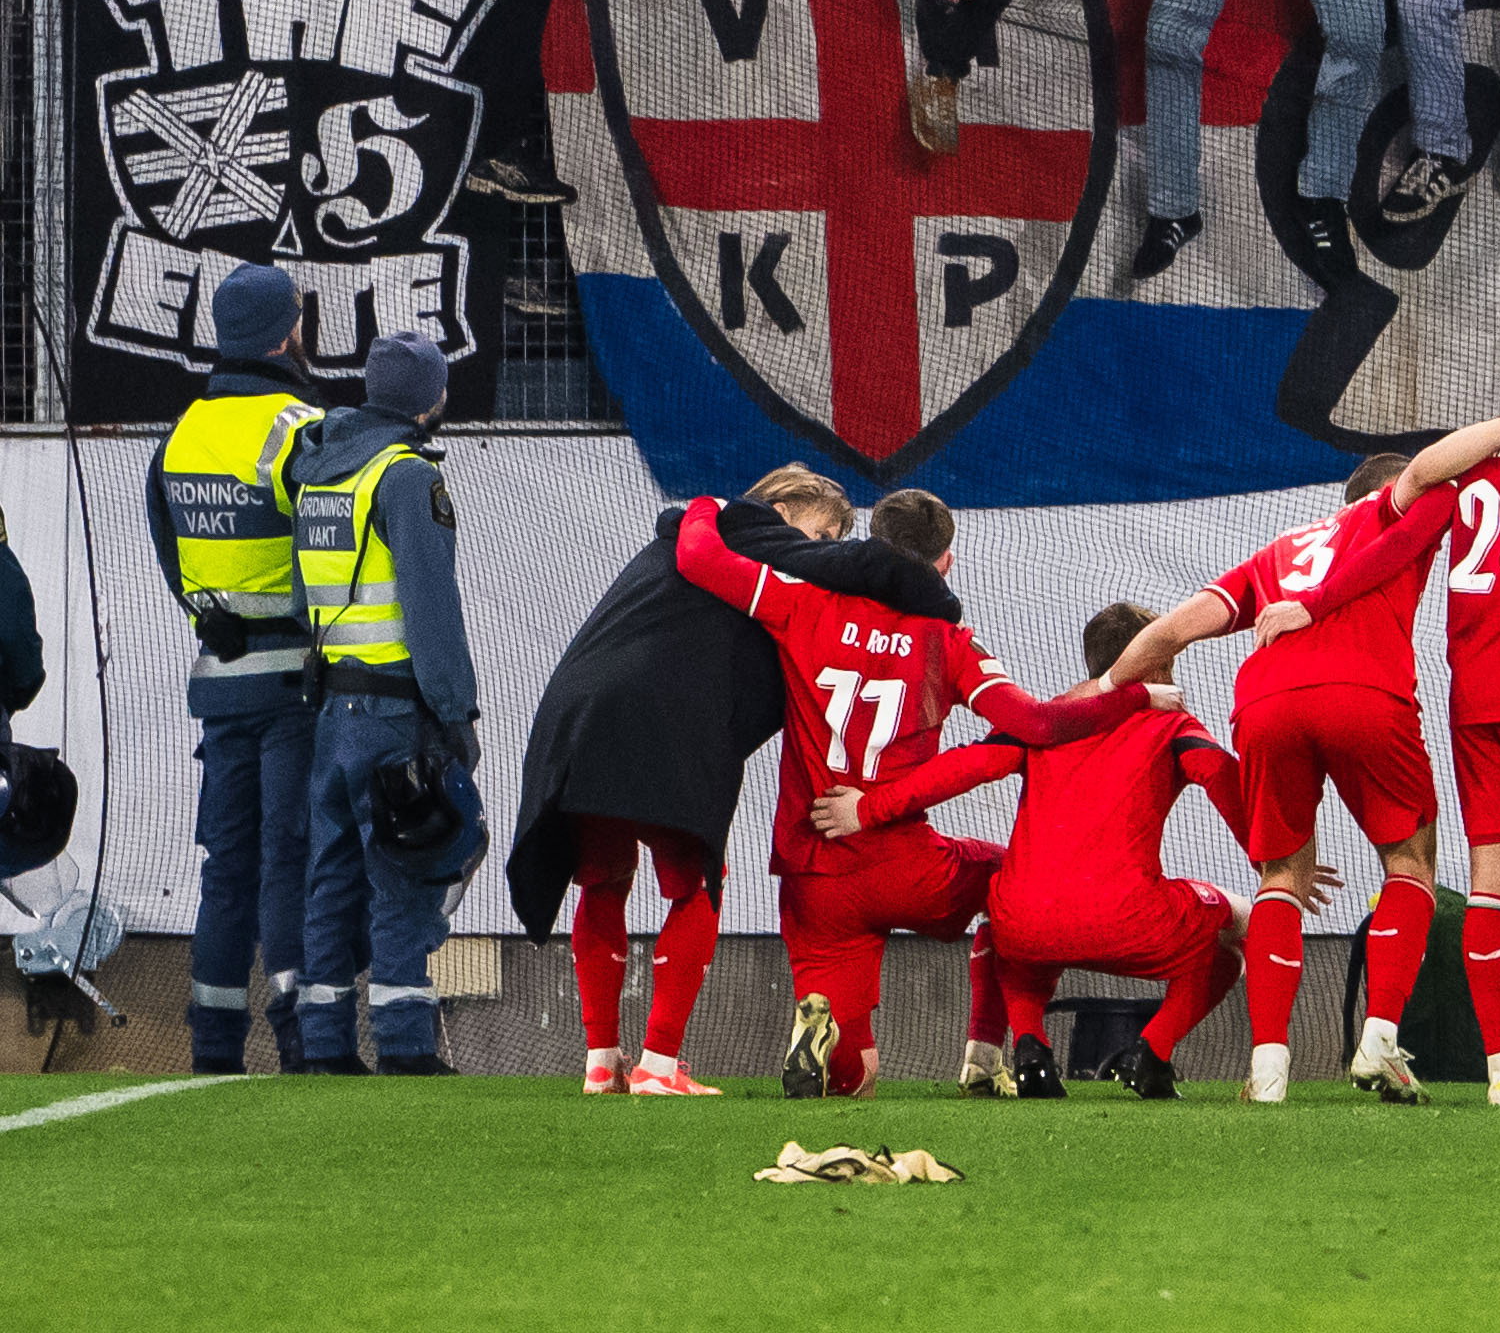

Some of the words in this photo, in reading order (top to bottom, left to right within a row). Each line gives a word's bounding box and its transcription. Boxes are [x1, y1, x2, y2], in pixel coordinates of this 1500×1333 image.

[299, 495, 353, 519] ORDNINGS
[184, 511, 237, 535] VAKT
[308, 525, 337, 547] VAKT
[1278, 522, 1342, 593] 3
[841, 621, 861, 649] D.
[815, 666, 908, 782] 11
